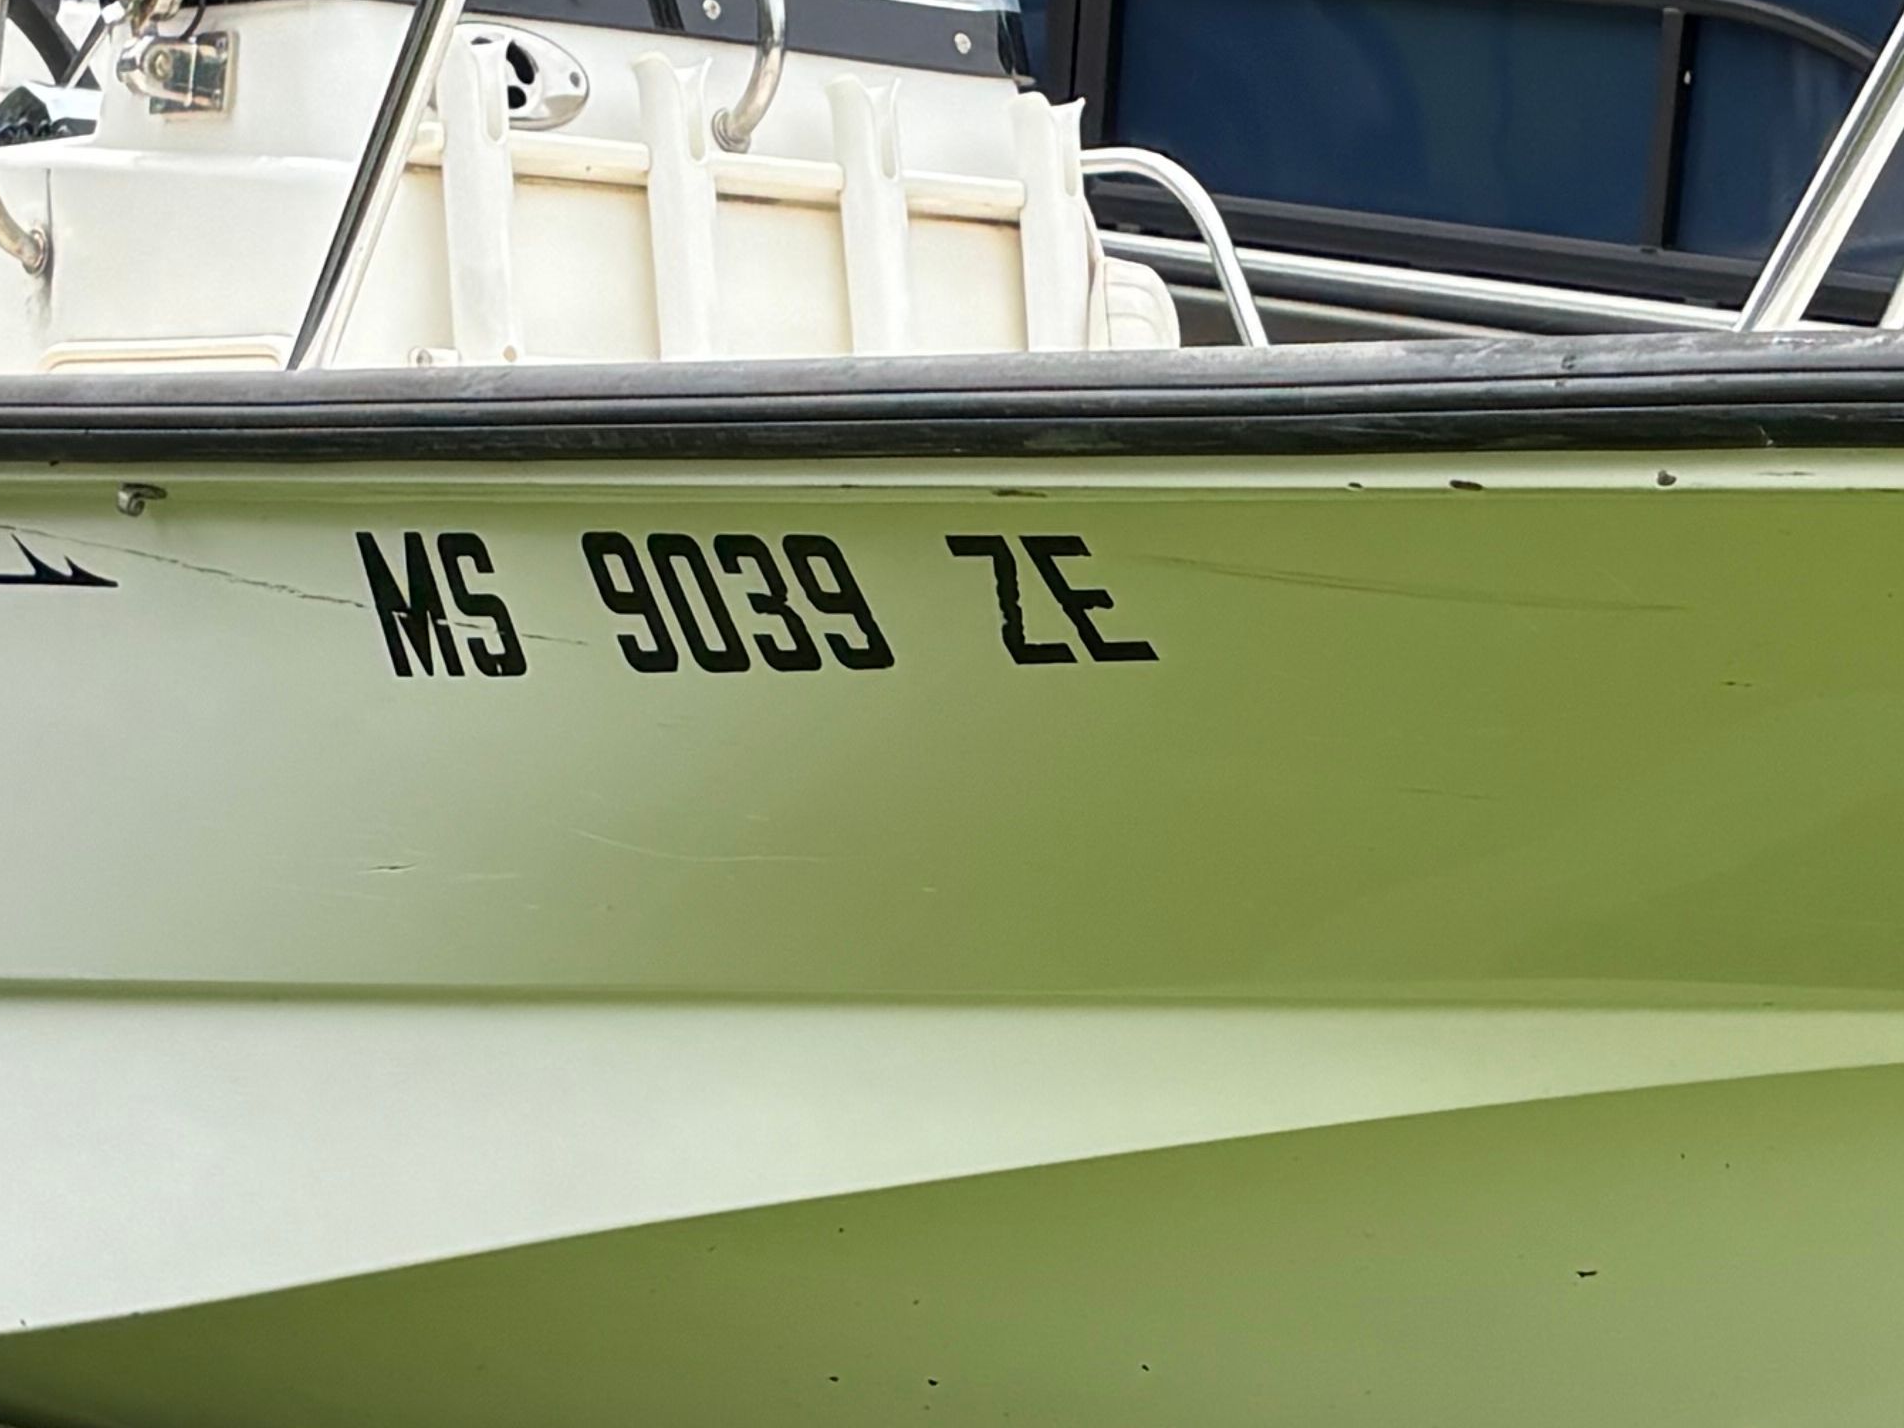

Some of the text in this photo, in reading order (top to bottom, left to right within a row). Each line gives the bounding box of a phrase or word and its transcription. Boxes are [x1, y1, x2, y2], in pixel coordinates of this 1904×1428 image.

[354, 529, 1161, 678] MS 9039 ZE
